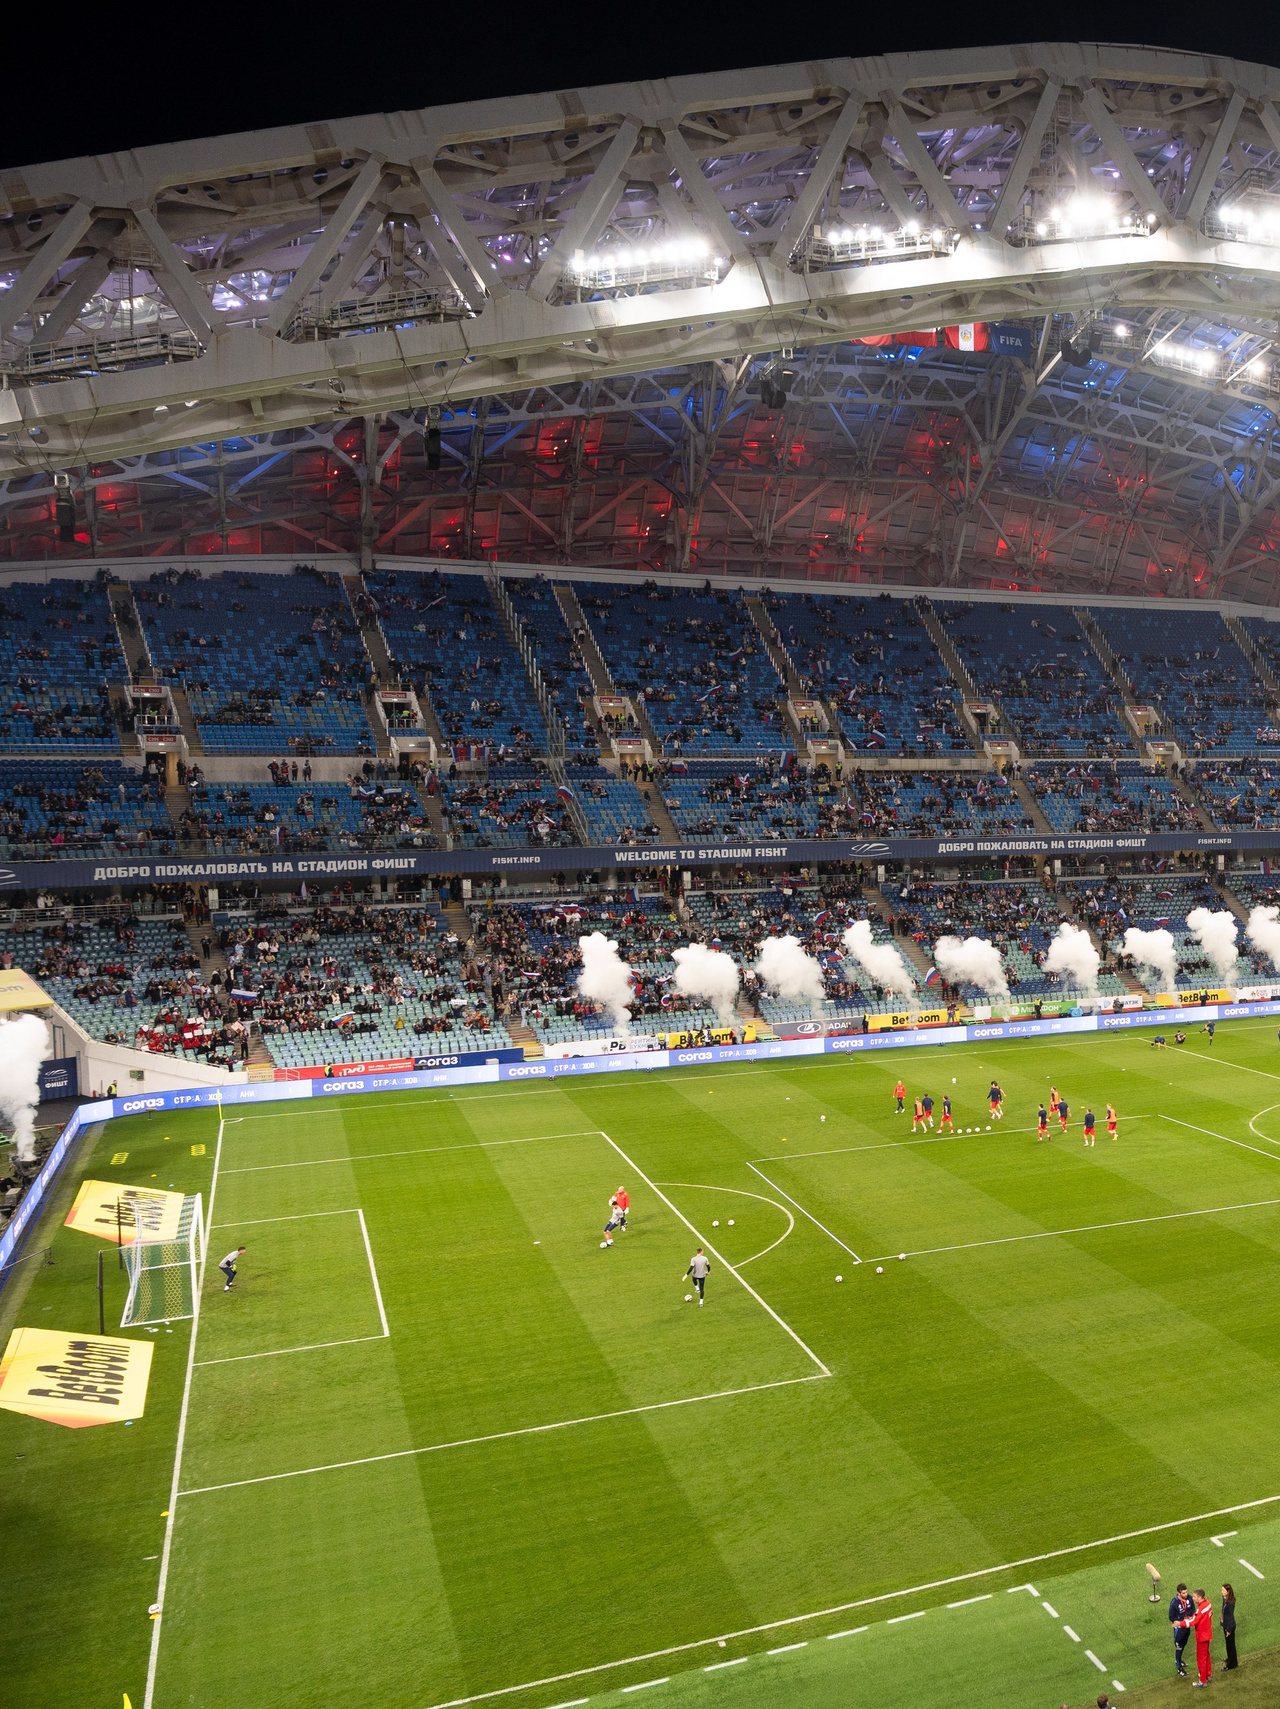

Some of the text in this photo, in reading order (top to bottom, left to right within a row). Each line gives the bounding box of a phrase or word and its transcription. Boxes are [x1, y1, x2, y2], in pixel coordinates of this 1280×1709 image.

[1000, 335, 1022, 347] FIFA
[938, 837, 1147, 854] ДОБРО ПОЖАЛОВАТЬ НА СТАДИОН ФИШТ
[1197, 837, 1232, 845] FISHT.INFO
[492, 856, 541, 864] FISHT.INFO
[614, 848, 787, 864] WELCOME TO STADIUM FISHT
[94, 857, 416, 881] ДОБРО ПОЖАЛОВАТЬ НА СТАДИОН ФИШТ
[45, 1080, 68, 1089] ФИШТ
[28, 1340, 130, 1406] BetBoom
